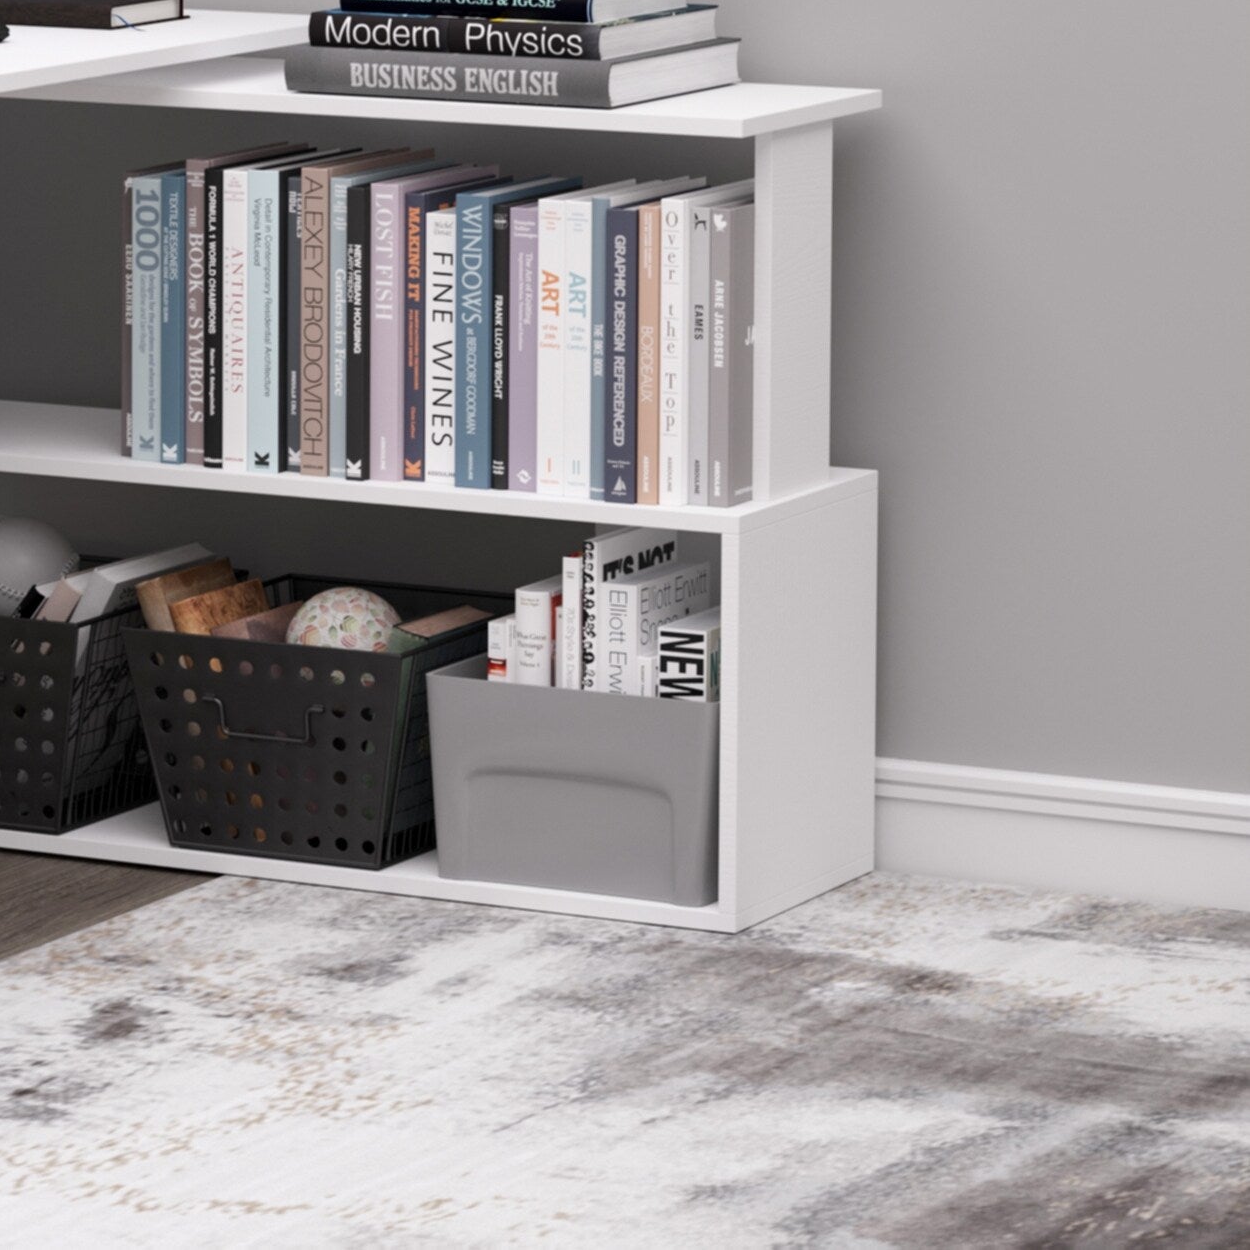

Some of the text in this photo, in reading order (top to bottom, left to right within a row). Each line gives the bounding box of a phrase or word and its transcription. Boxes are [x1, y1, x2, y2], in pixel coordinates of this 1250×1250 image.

[324, 15, 583, 57] Modern Physics
[350, 62, 559, 97] BUSINESS ENGLISH
[135, 189, 160, 271] 1000
[169, 192, 179, 281] TEXTILE DESIGNERS
[208, 185, 217, 231] FORMULA
[252, 198, 261, 267] Virginia McLeod
[264, 198, 273, 222] Detail
[304, 176, 324, 279] ALEXEY
[408, 207, 421, 278] MAKING
[208, 241, 217, 276] WORLD
[262, 235, 273, 294] Contemporary
[375, 193, 393, 320] LOST FISH
[614, 235, 626, 297] GRAPHIC
[665, 210, 678, 280] Over
[189, 207, 204, 423] THE BOOK OF SYMBOLS
[208, 278, 217, 334] CHAMPIONS
[230, 246, 244, 394] ANTIQUAIRES
[264, 297, 272, 344] Residential
[353, 243, 362, 354] NEW URBAN HOUSING
[408, 283, 421, 302] IT
[432, 252, 453, 323] FINE
[461, 204, 482, 435] WINDOWS at BERGDORF GOODMAN
[541, 270, 559, 316] ART
[569, 272, 586, 318] ART
[334, 268, 346, 397] Gardens in France
[494, 295, 504, 399] FRANK LLOYD WRIGHT
[614, 301, 626, 352] DESIGN
[665, 303, 677, 355] the
[694, 305, 704, 340] EAMES
[714, 279, 724, 368] ARNE JACOBSEN
[264, 346, 272, 397] Architecture
[303, 287, 323, 456] BRODOVITCH
[431, 340, 453, 446] WINES
[641, 325, 654, 403] BORDEAUX
[613, 355, 625, 447] REFERENCED
[603, 541, 675, 582] IT'S NOT
[641, 584, 671, 615] Elliott
[609, 589, 628, 695] Elliott Erwi
[660, 630, 704, 698] NEW
